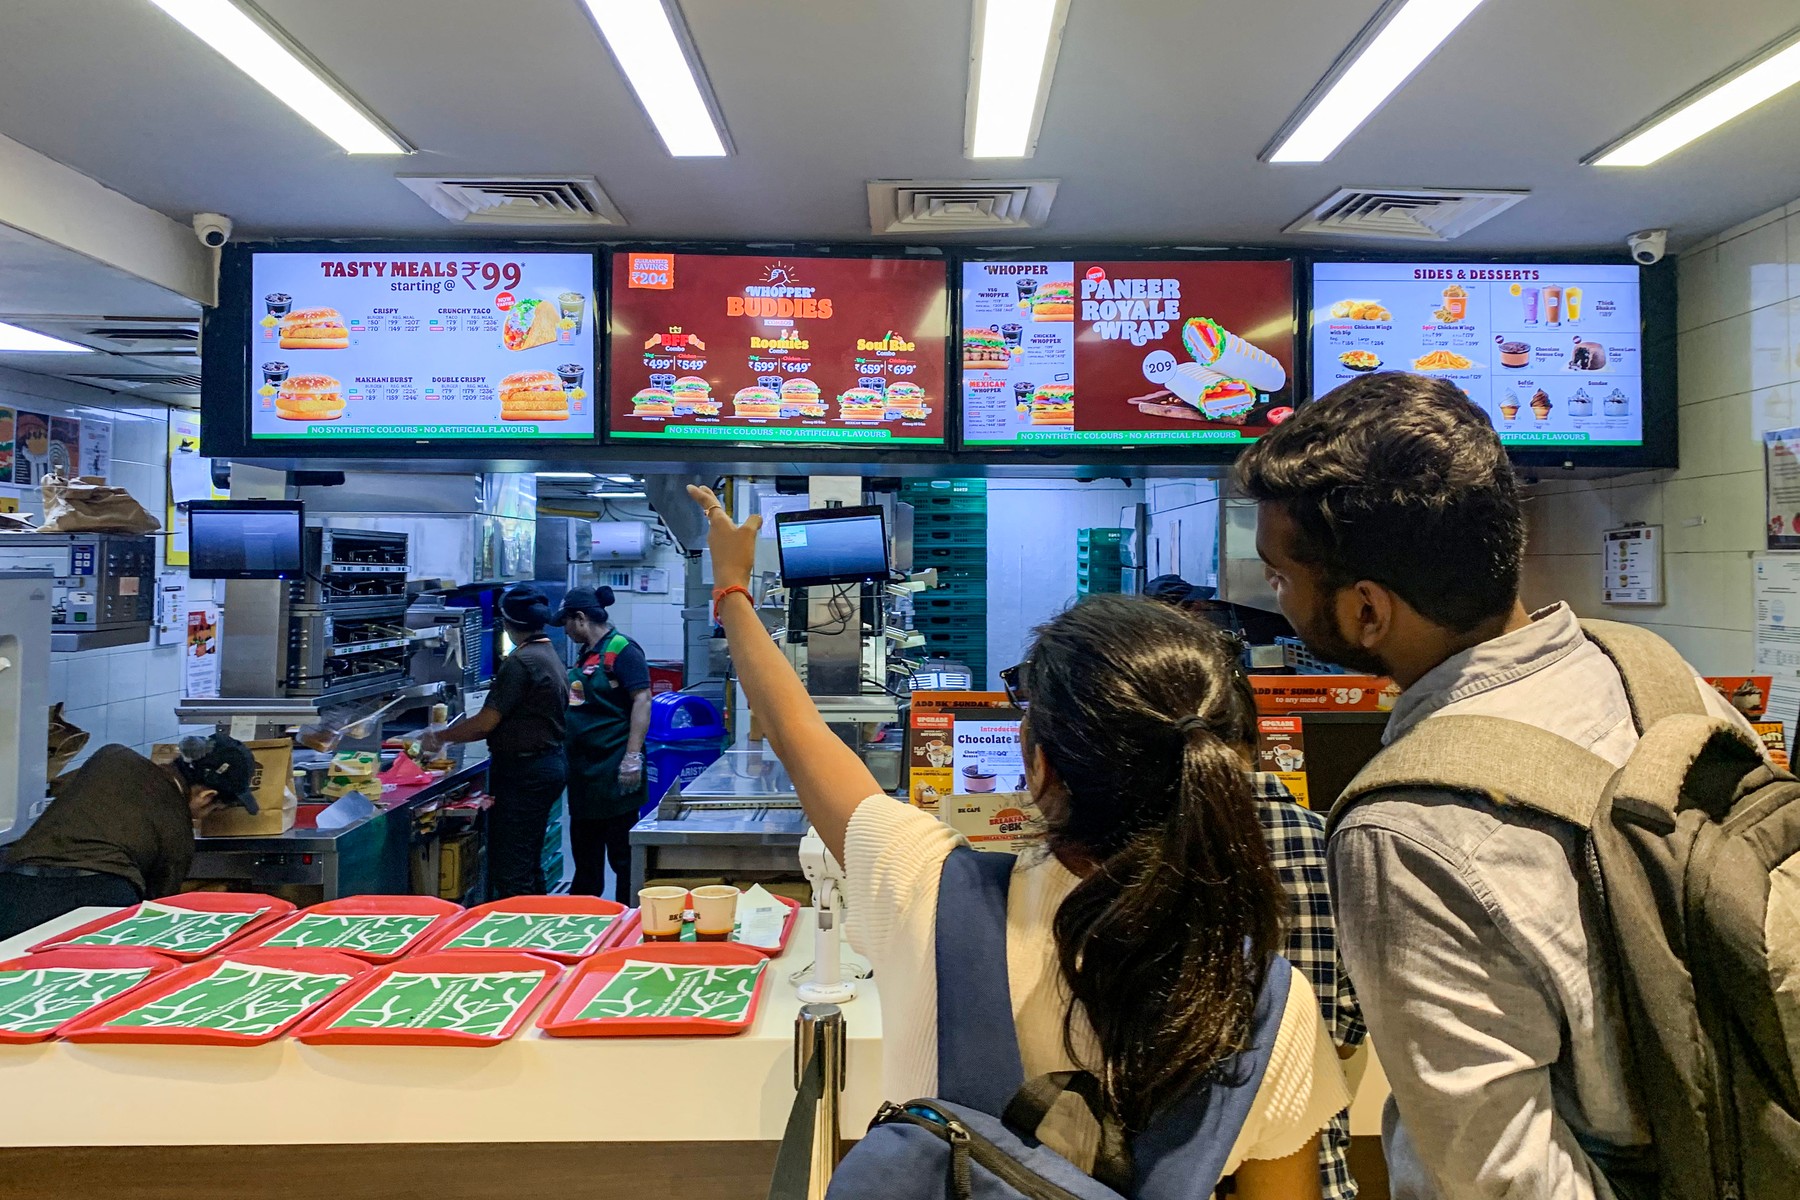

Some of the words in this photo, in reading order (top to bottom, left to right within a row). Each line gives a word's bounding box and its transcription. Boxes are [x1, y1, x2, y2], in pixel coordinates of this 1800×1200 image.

[321, 261, 387, 277] TASTY
[391, 261, 458, 278] MEALS
[983, 265, 1048, 275] WHOPPER
[1414, 269, 1453, 279] SIDES
[1456, 269, 1466, 279] &
[1470, 270, 1539, 280] DESSERTS
[390, 280, 442, 294] starting
[444, 280, 456, 292] @
[745, 286, 816, 298] WHOPPER
[1081, 279, 1181, 299] PANEER
[727, 296, 833, 319] BUDDIES
[1081, 300, 1181, 321] ROYALE
[1092, 320, 1170, 346] WRAP
[661, 334, 689, 346] BFF
[750, 336, 810, 350] Roomies
[857, 338, 888, 351] Soul
[889, 339, 915, 351] Bae
[311, 426, 325, 434] NO
[326, 426, 375, 434] SYNTHETIC
[376, 426, 418, 434] COLOURS
[424, 426, 438, 434] NO
[439, 426, 487, 434] ARTIFICIAL
[488, 426, 534, 434] FLAVOURS
[794, 429, 840, 437] ARTIFICIAL
[842, 430, 887, 438] FLAVOURS
[1020, 432, 1033, 440] NO
[1034, 432, 1082, 440] SYNTHETIC
[1083, 432, 1124, 440] COLOURS
[1191, 431, 1236, 439] FLAVOURS
[958, 735, 1012, 744] Chocolate
[999, 823, 1022, 833] @BK
